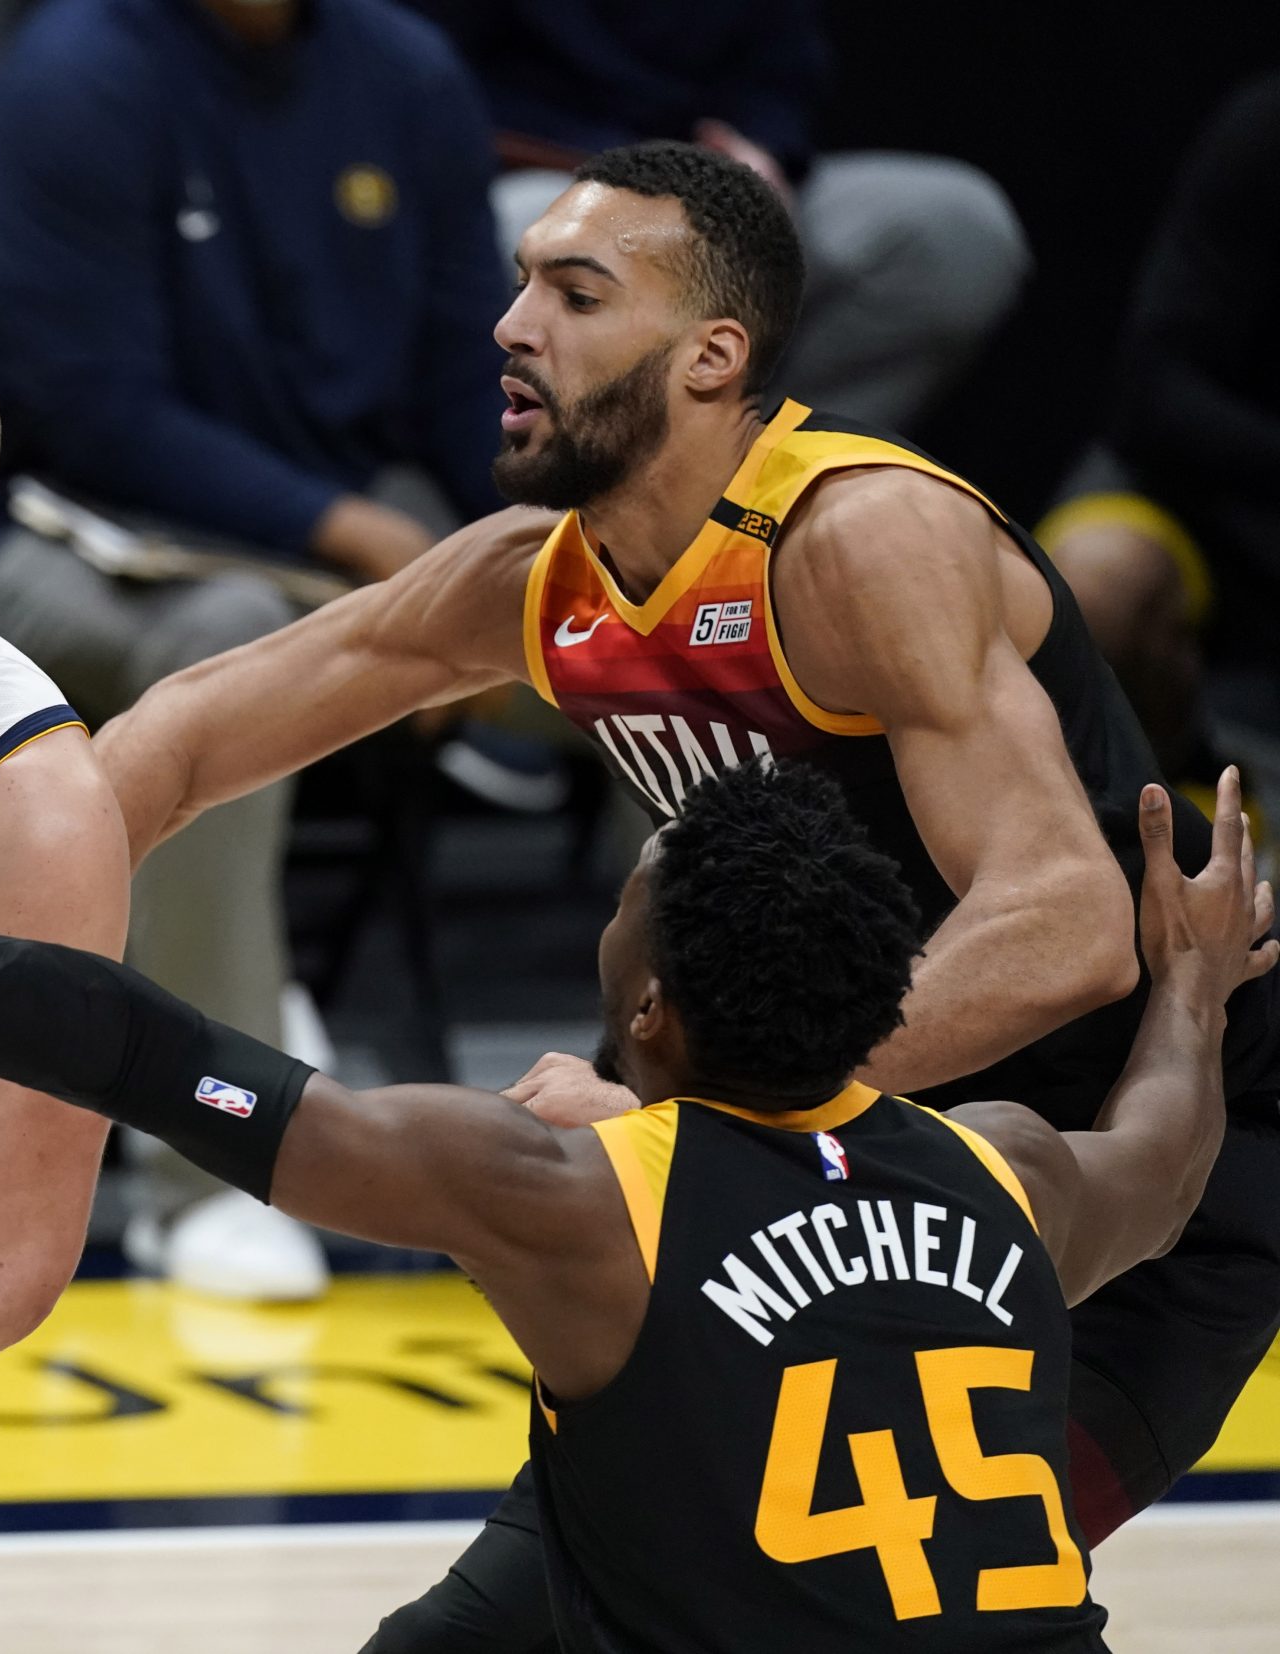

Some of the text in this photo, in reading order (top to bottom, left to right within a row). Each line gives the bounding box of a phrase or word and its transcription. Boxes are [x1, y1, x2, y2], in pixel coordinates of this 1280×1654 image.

[695, 608, 717, 642] 5
[725, 603, 750, 616] FOR THE
[718, 622, 750, 640] FIGHT
[700, 1199, 1024, 1347] MITCHELL
[754, 1346, 1087, 1621] 45
